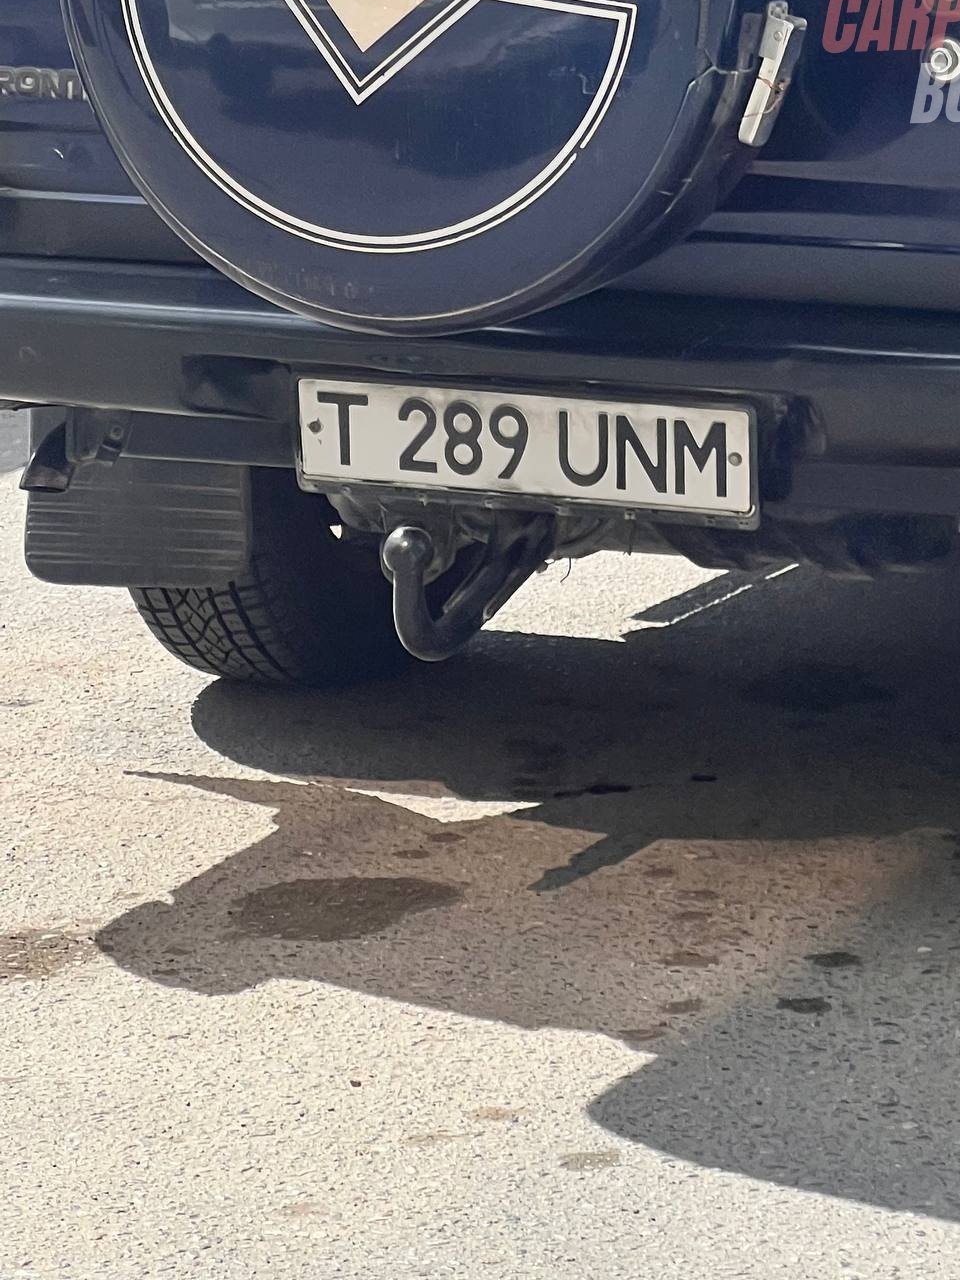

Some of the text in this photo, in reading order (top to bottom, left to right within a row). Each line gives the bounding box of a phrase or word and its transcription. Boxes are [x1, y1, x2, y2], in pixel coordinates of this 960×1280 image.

[317, 391, 727, 498] T 289 UNM
